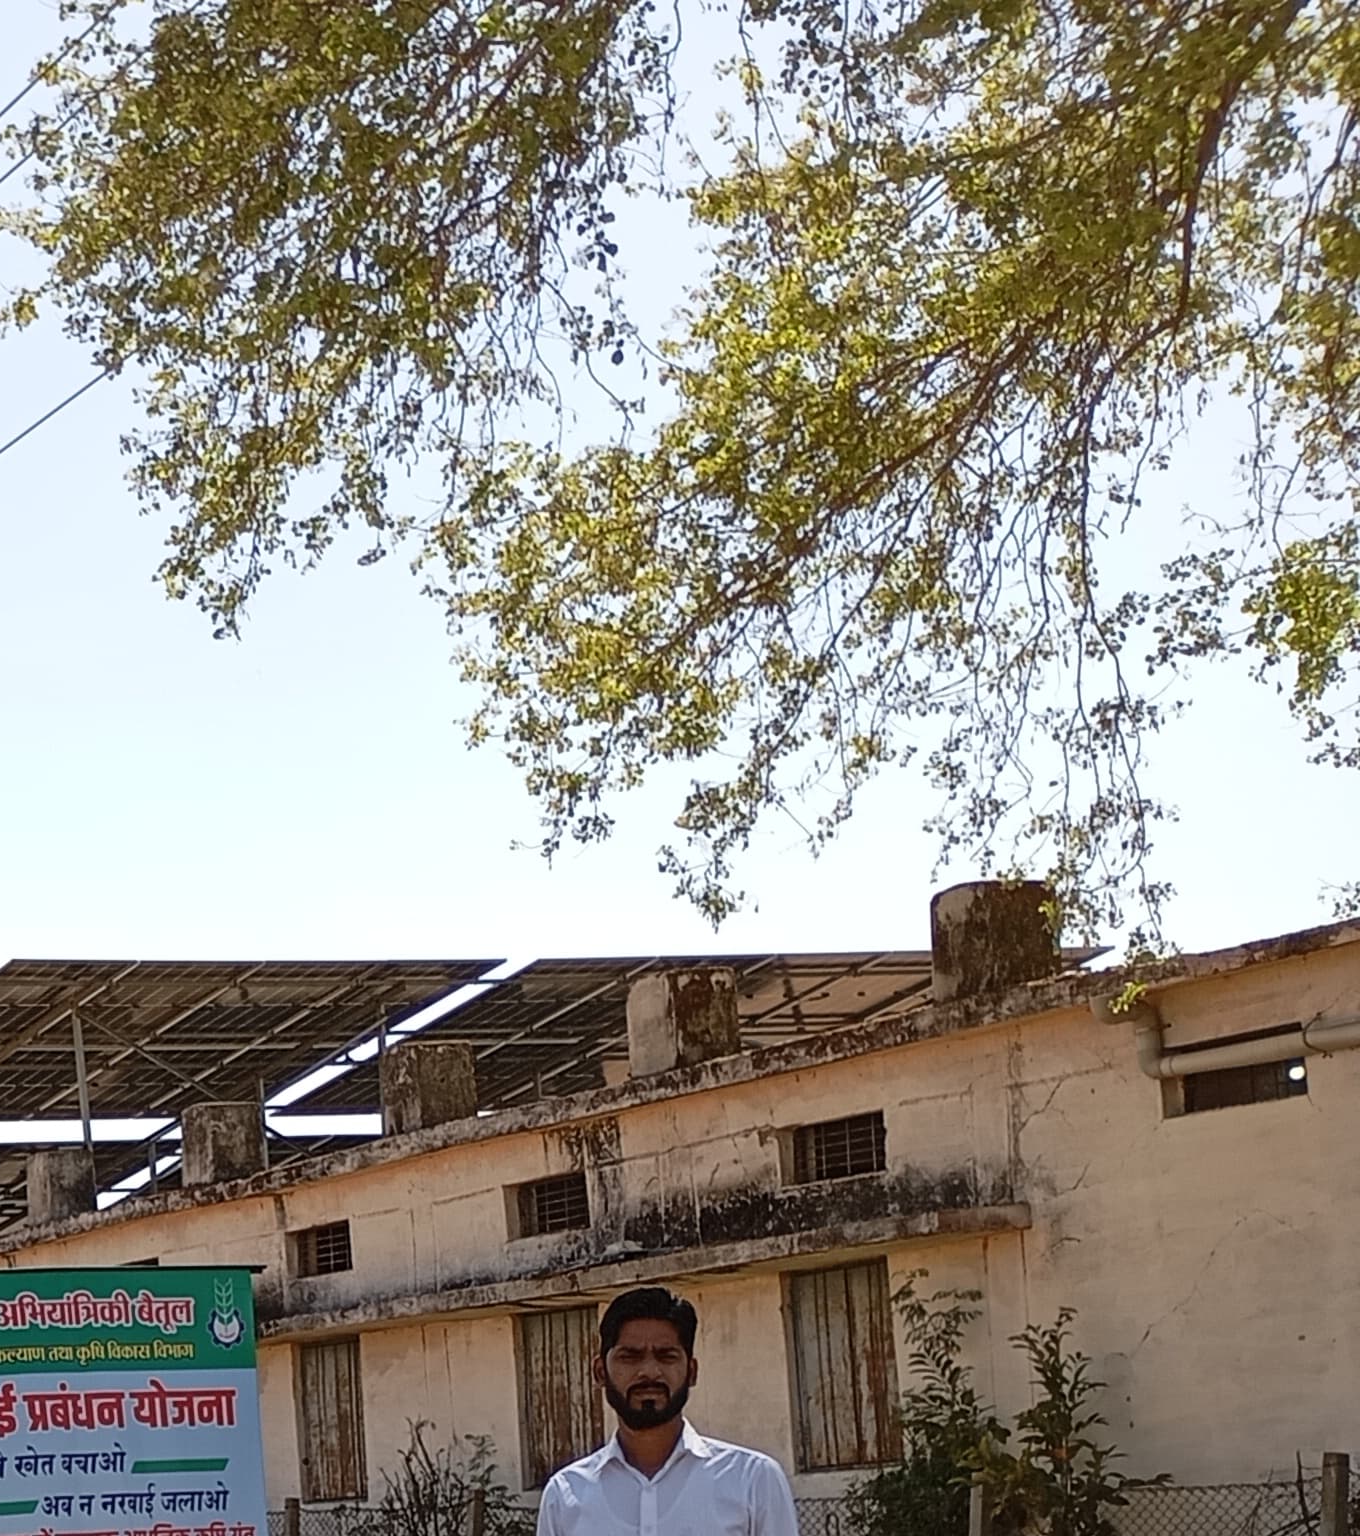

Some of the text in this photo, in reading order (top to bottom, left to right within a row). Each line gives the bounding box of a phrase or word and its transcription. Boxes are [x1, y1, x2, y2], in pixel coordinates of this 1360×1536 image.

[135, 1289, 195, 1334] बैतूल
[48, 1346, 73, 1361] तथा
[76, 1341, 105, 1365] कृषि
[107, 1340, 150, 1360] विकास
[154, 1339, 194, 1359] विभाग
[23, 1382, 125, 1432] प्रबंधन
[130, 1379, 236, 1429] योजना
[14, 1446, 55, 1477] खेत
[79, 1494, 95, 1515] न
[101, 1483, 155, 1518] नरवाई
[161, 1481, 229, 1512] जलाओ
